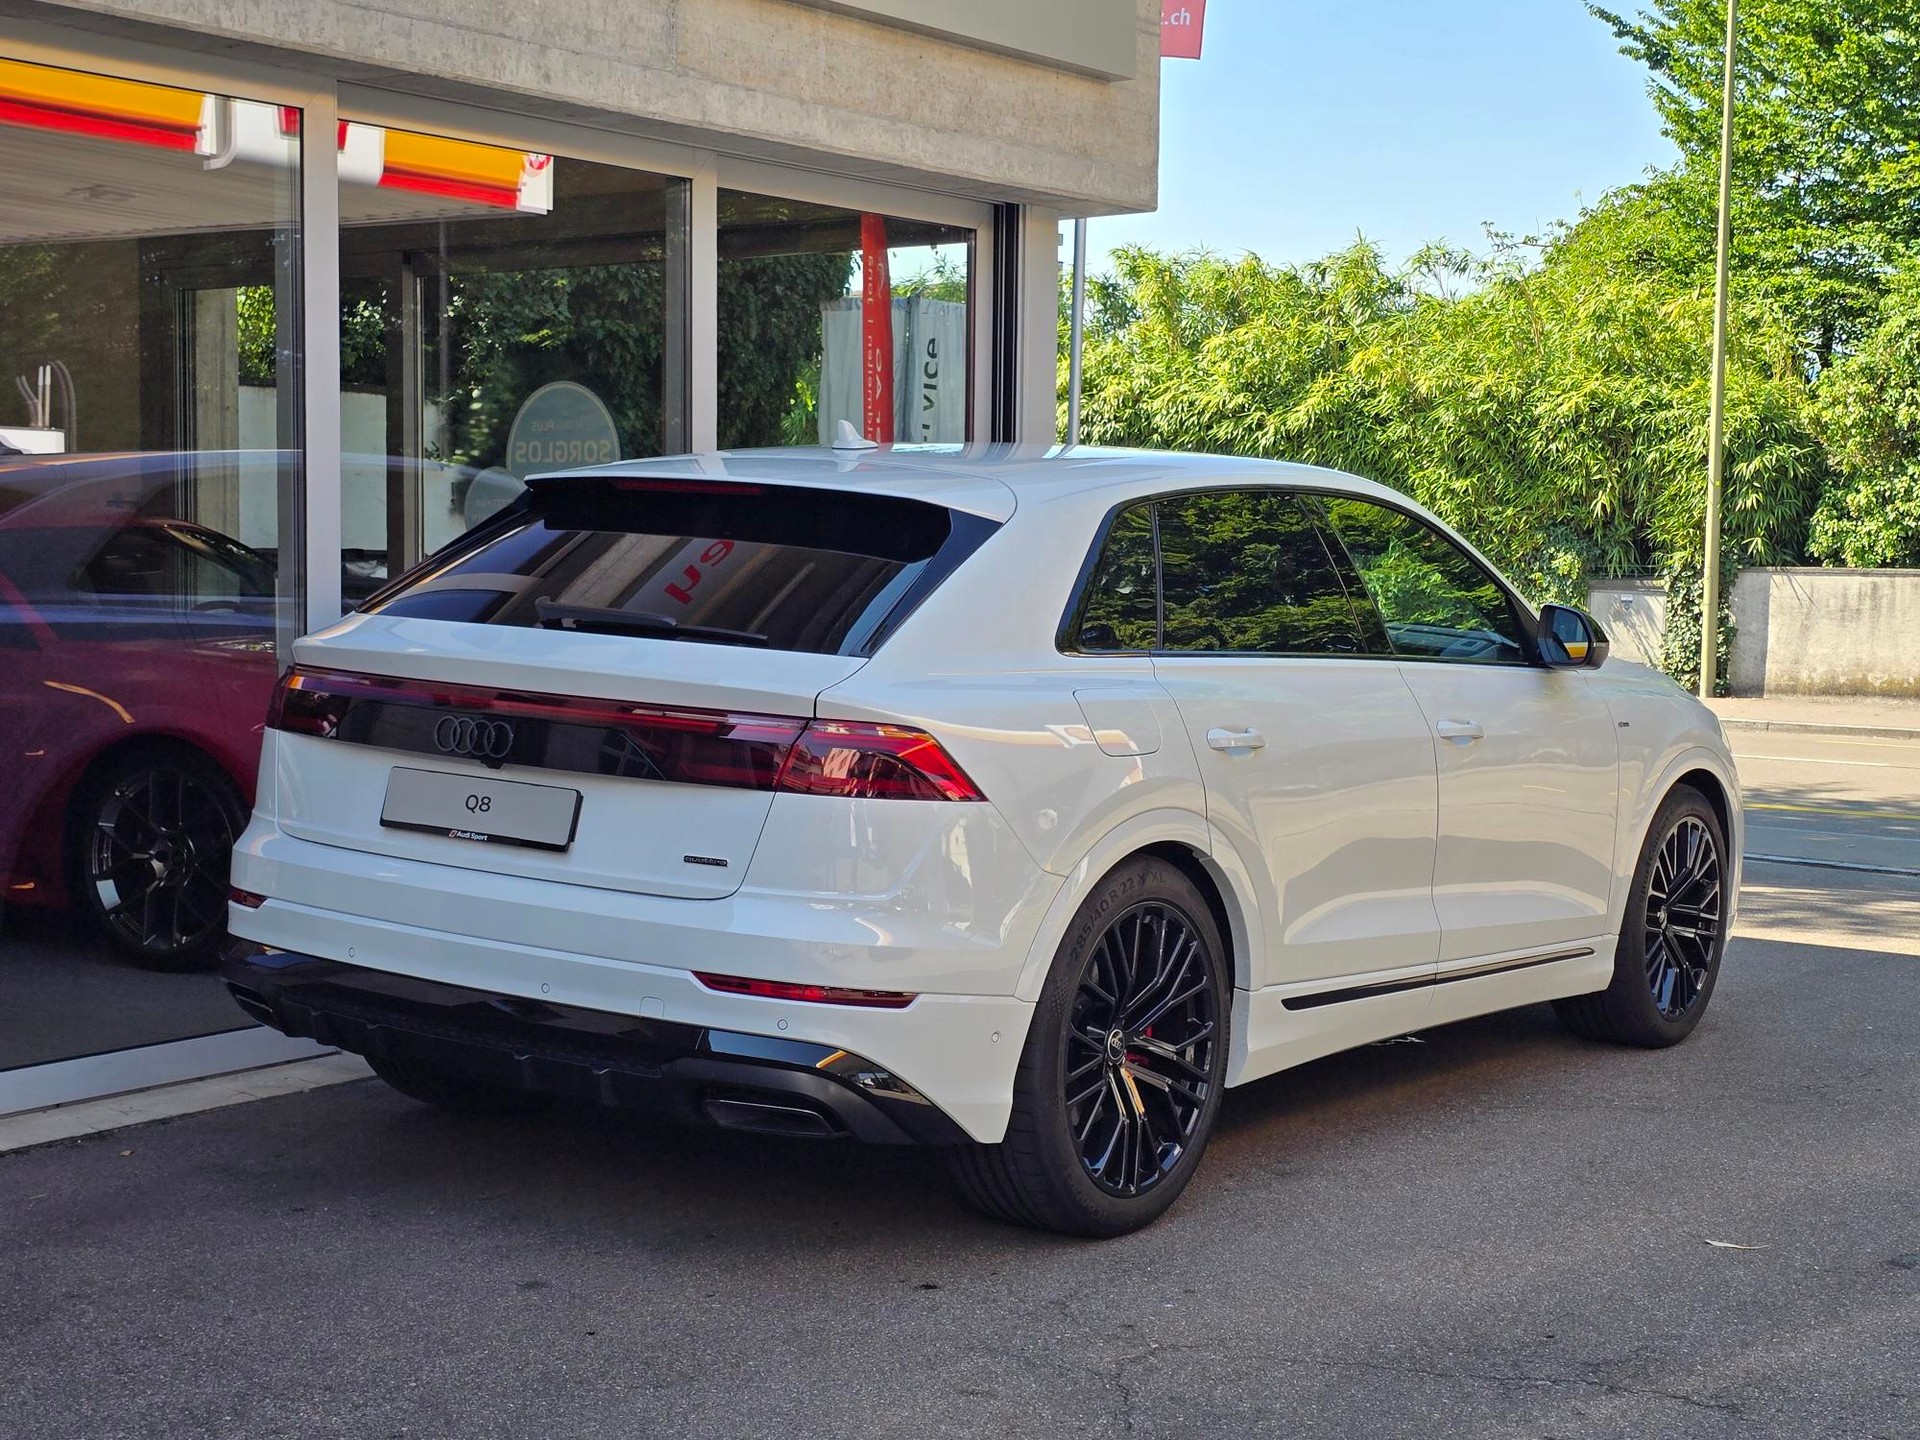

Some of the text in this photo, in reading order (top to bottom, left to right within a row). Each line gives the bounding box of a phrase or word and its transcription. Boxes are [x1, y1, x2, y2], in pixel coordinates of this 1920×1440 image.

[922, 337, 939, 442] vice
[465, 794, 492, 814] Q8
[456, 830, 488, 841] Audi Sport
[684, 855, 728, 867] quattro
[1070, 899, 1110, 961] 285/40
[1119, 876, 1137, 895] 22
